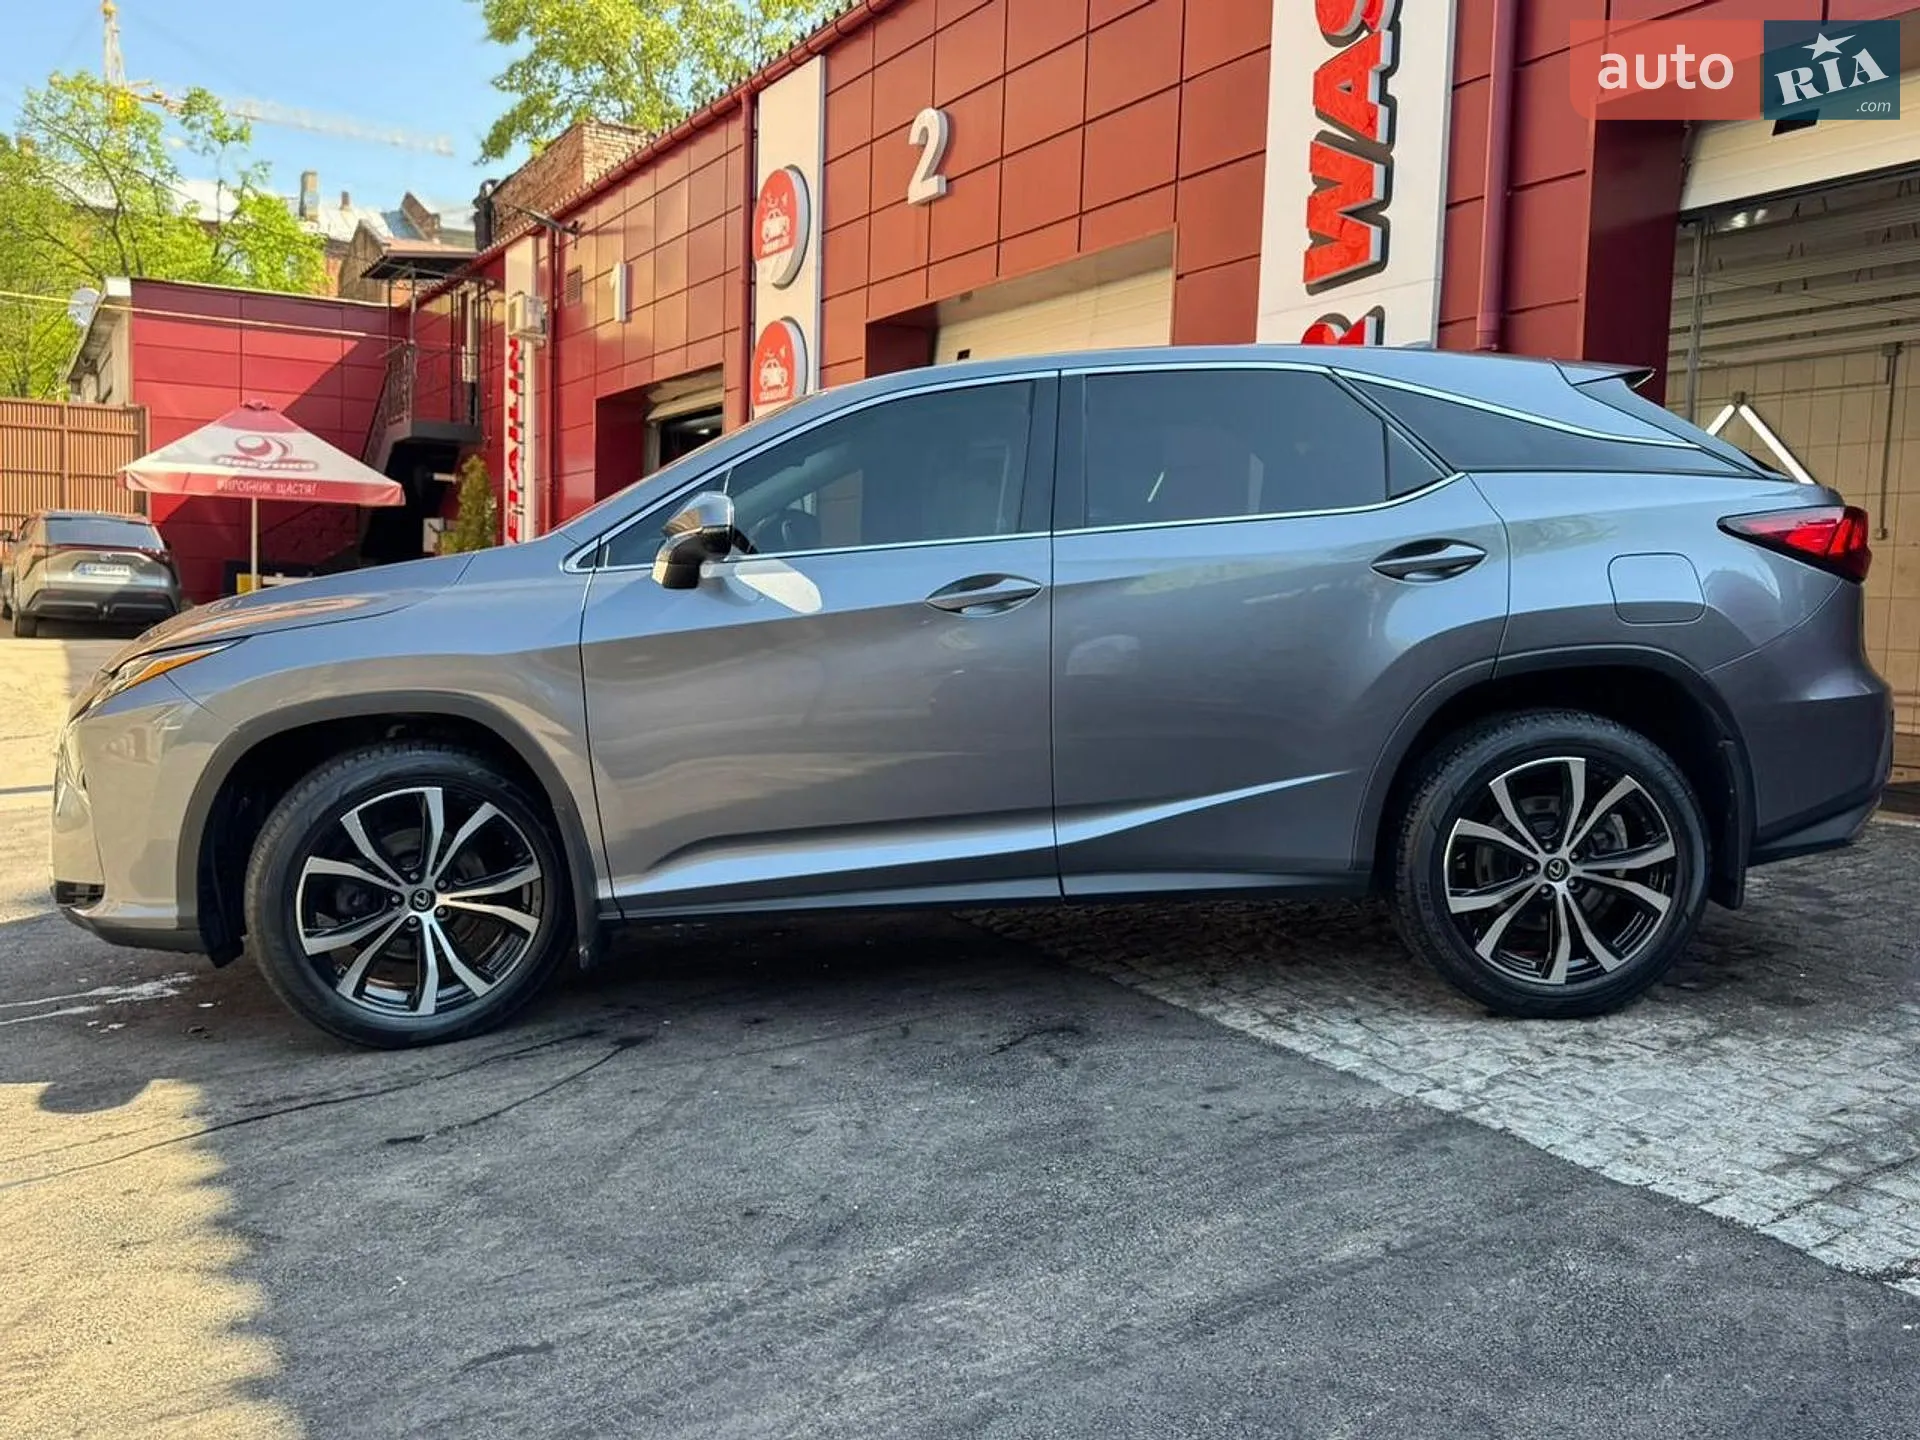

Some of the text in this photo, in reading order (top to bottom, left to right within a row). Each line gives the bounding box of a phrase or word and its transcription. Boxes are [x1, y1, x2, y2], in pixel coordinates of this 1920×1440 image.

[907, 107, 949, 206] 2
[610, 262, 627, 322] 1
[507, 336, 522, 543] ETAILIN
